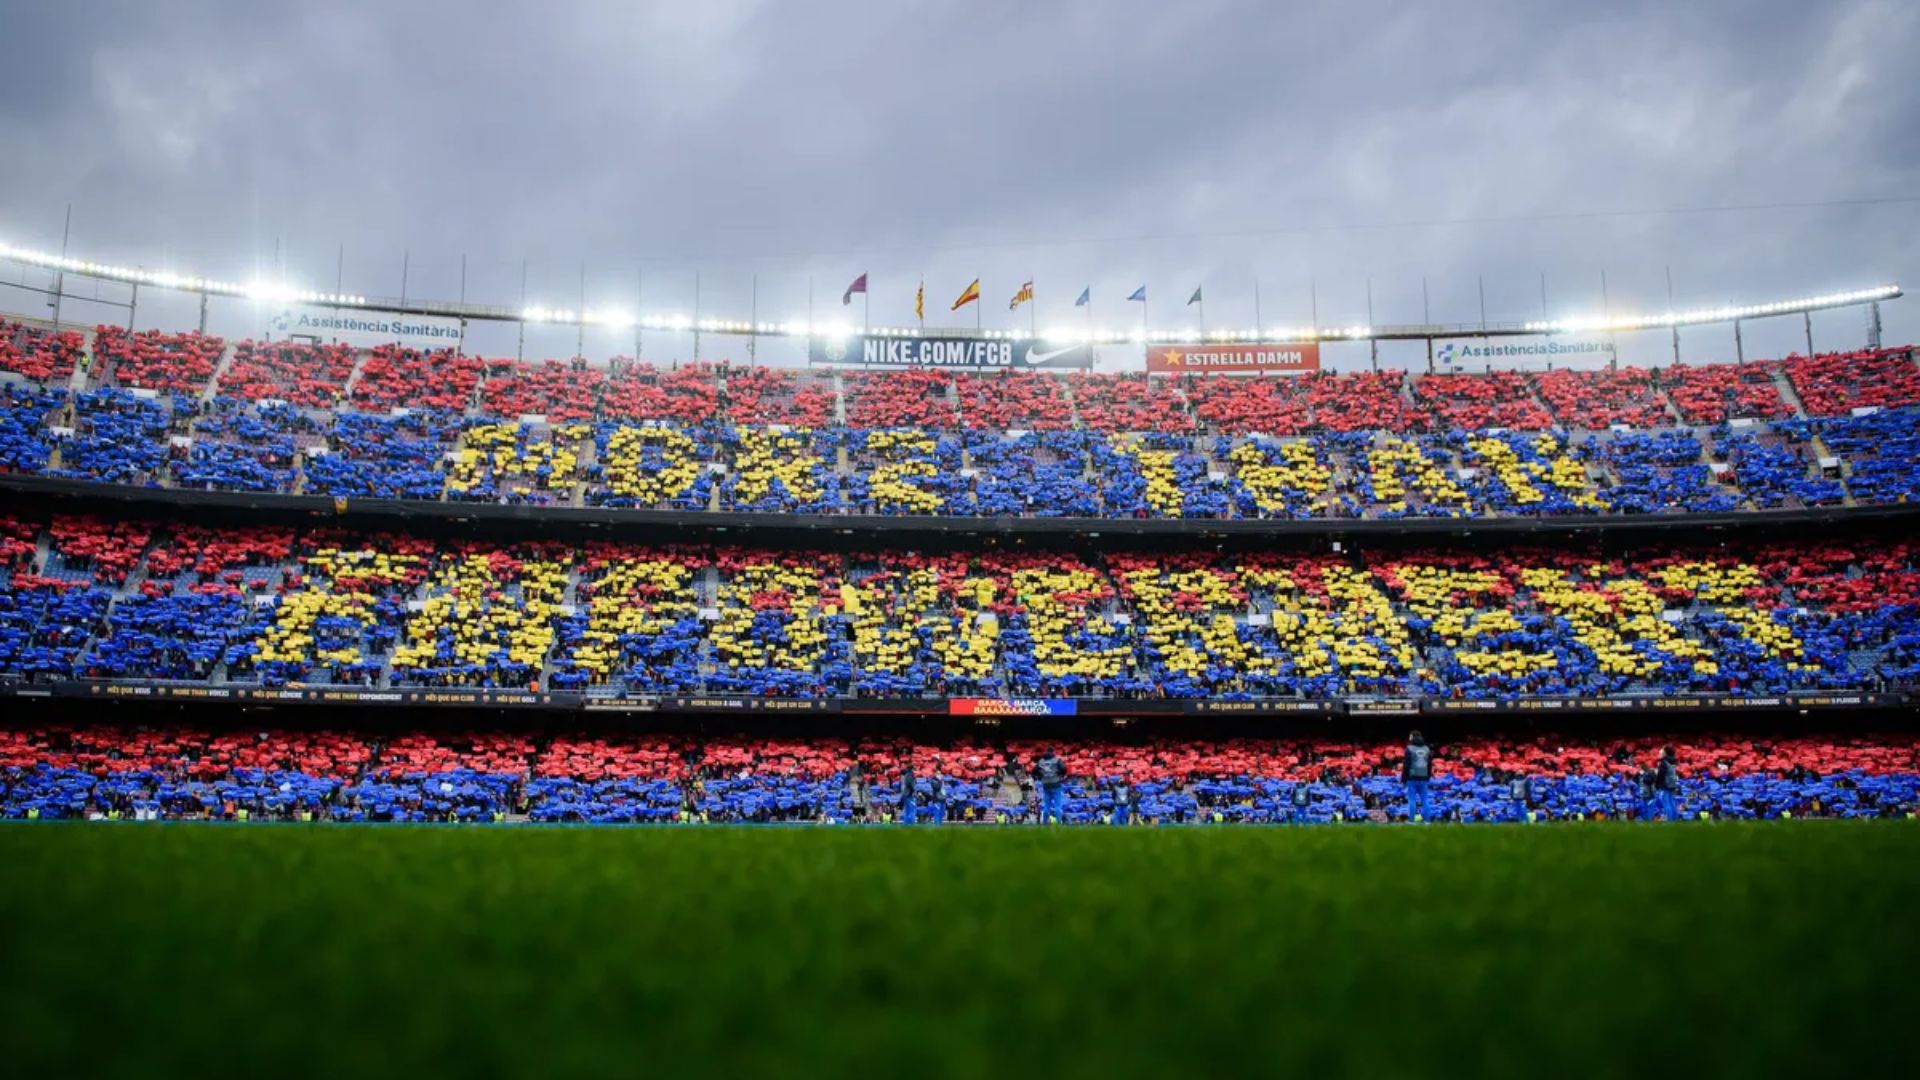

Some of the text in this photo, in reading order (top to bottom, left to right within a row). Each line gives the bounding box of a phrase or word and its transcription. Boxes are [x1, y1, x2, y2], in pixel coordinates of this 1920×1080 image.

[298, 314, 459, 338] Assistència Sanitària
[864, 339, 1012, 365] NIKE.COM/FCB
[1185, 351, 1302, 365] ESTRELLA DAMM
[1461, 343, 1547, 357] Assistència
